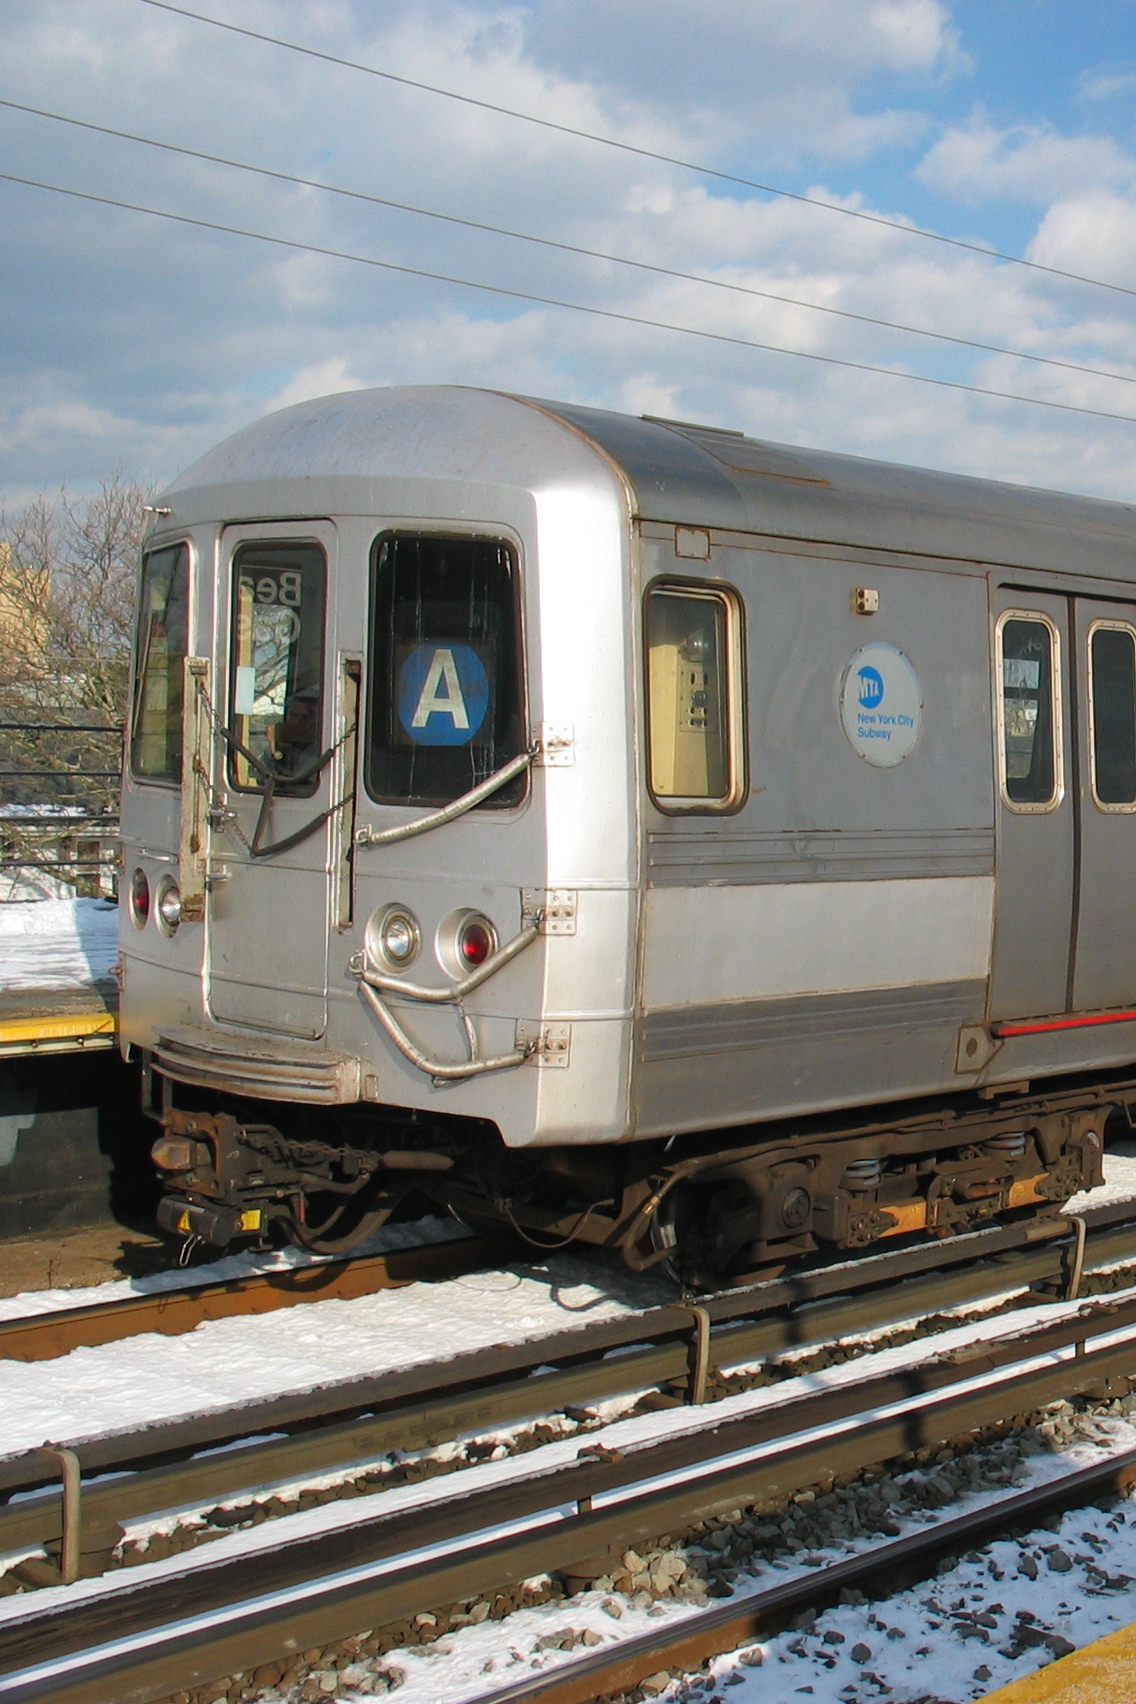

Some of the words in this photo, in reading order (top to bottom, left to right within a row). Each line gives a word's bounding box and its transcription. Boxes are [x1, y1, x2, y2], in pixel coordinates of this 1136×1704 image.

[411, 649, 470, 729] A
[857, 675, 880, 700] MTA
[857, 713, 877, 724] New
[878, 714, 896, 725] York
[897, 715, 914, 727] City
[857, 727, 891, 741] Subway
